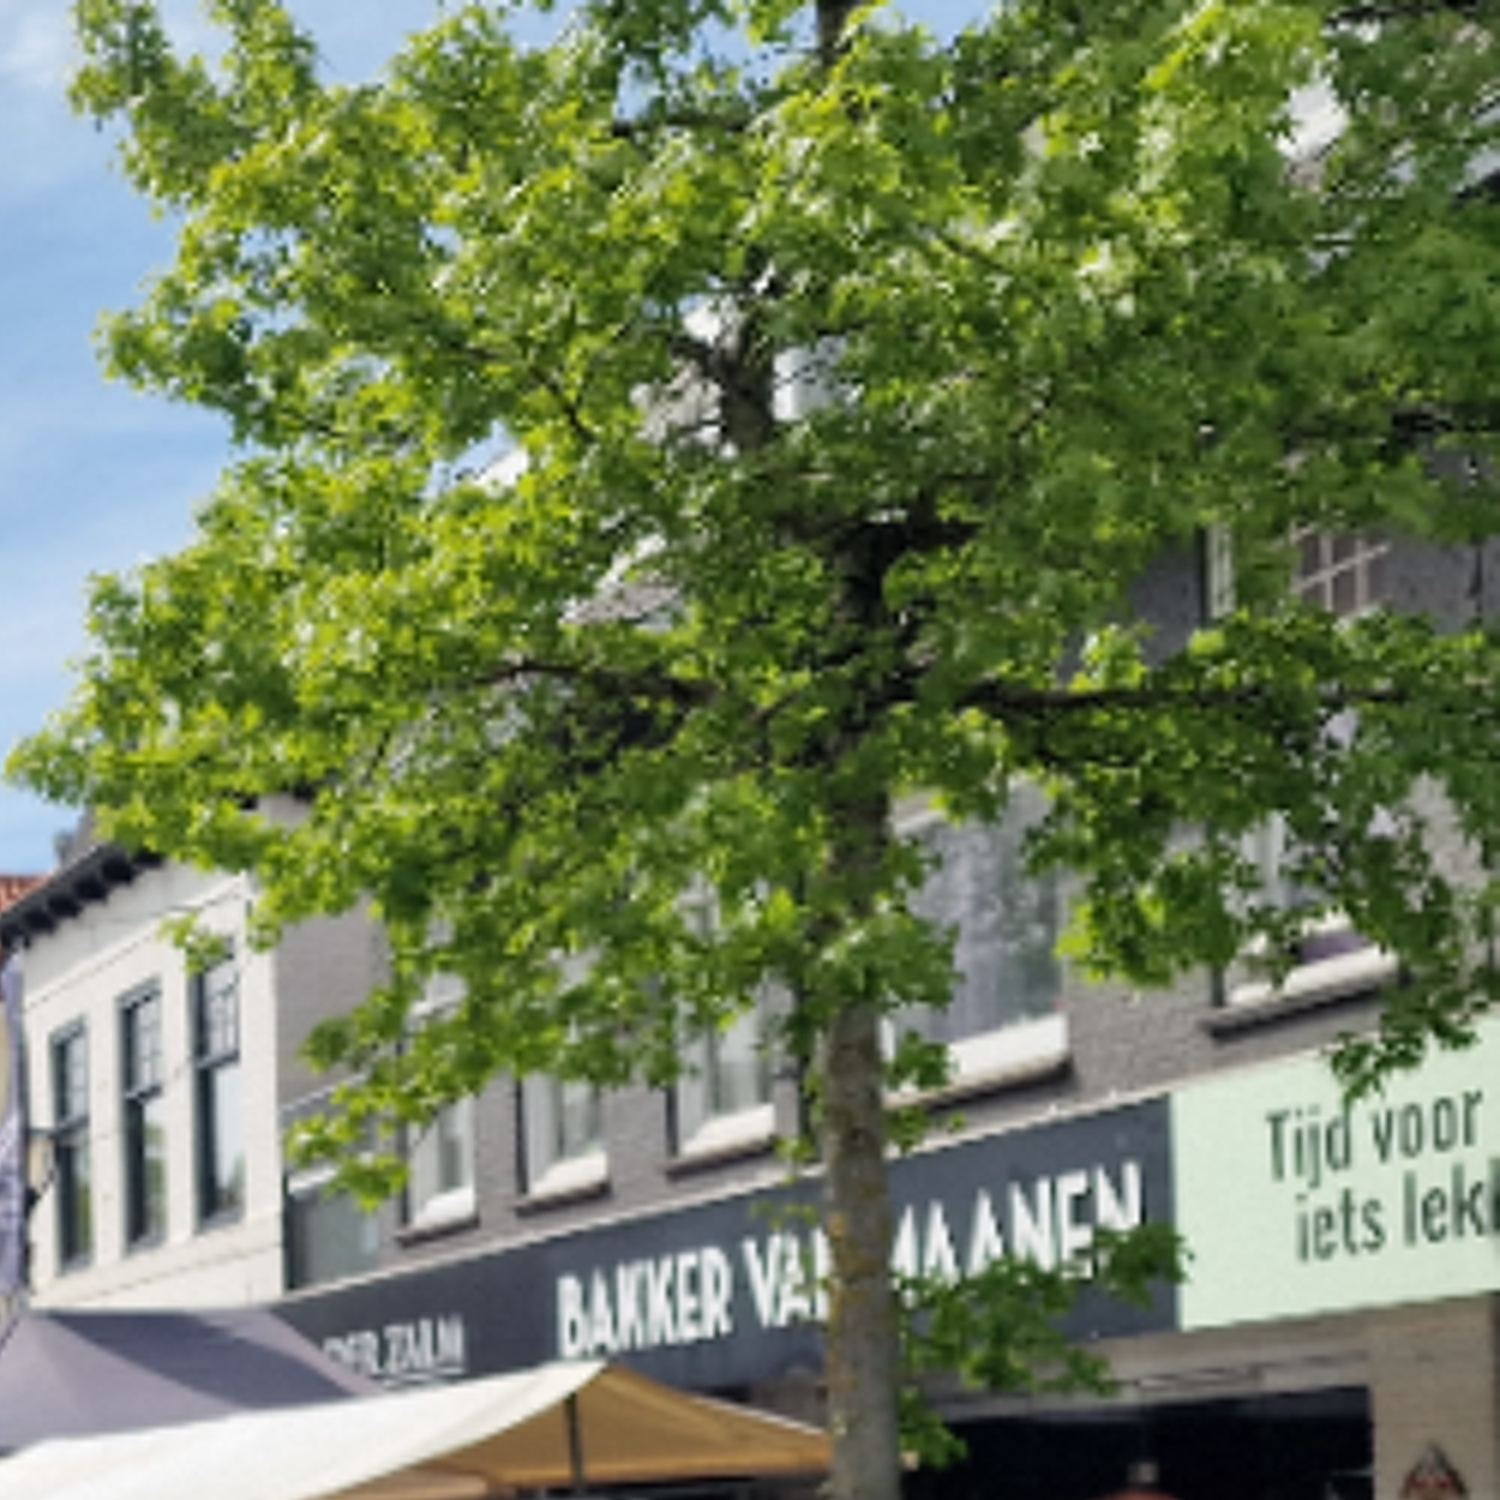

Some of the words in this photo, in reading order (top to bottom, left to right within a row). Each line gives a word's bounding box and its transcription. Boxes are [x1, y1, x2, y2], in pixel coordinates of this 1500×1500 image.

[1265, 1101, 1352, 1189] Tijd
[1370, 1089, 1484, 1165] voor
[1295, 1186, 1387, 1264] iets
[556, 1246, 732, 1358] BAKKER
